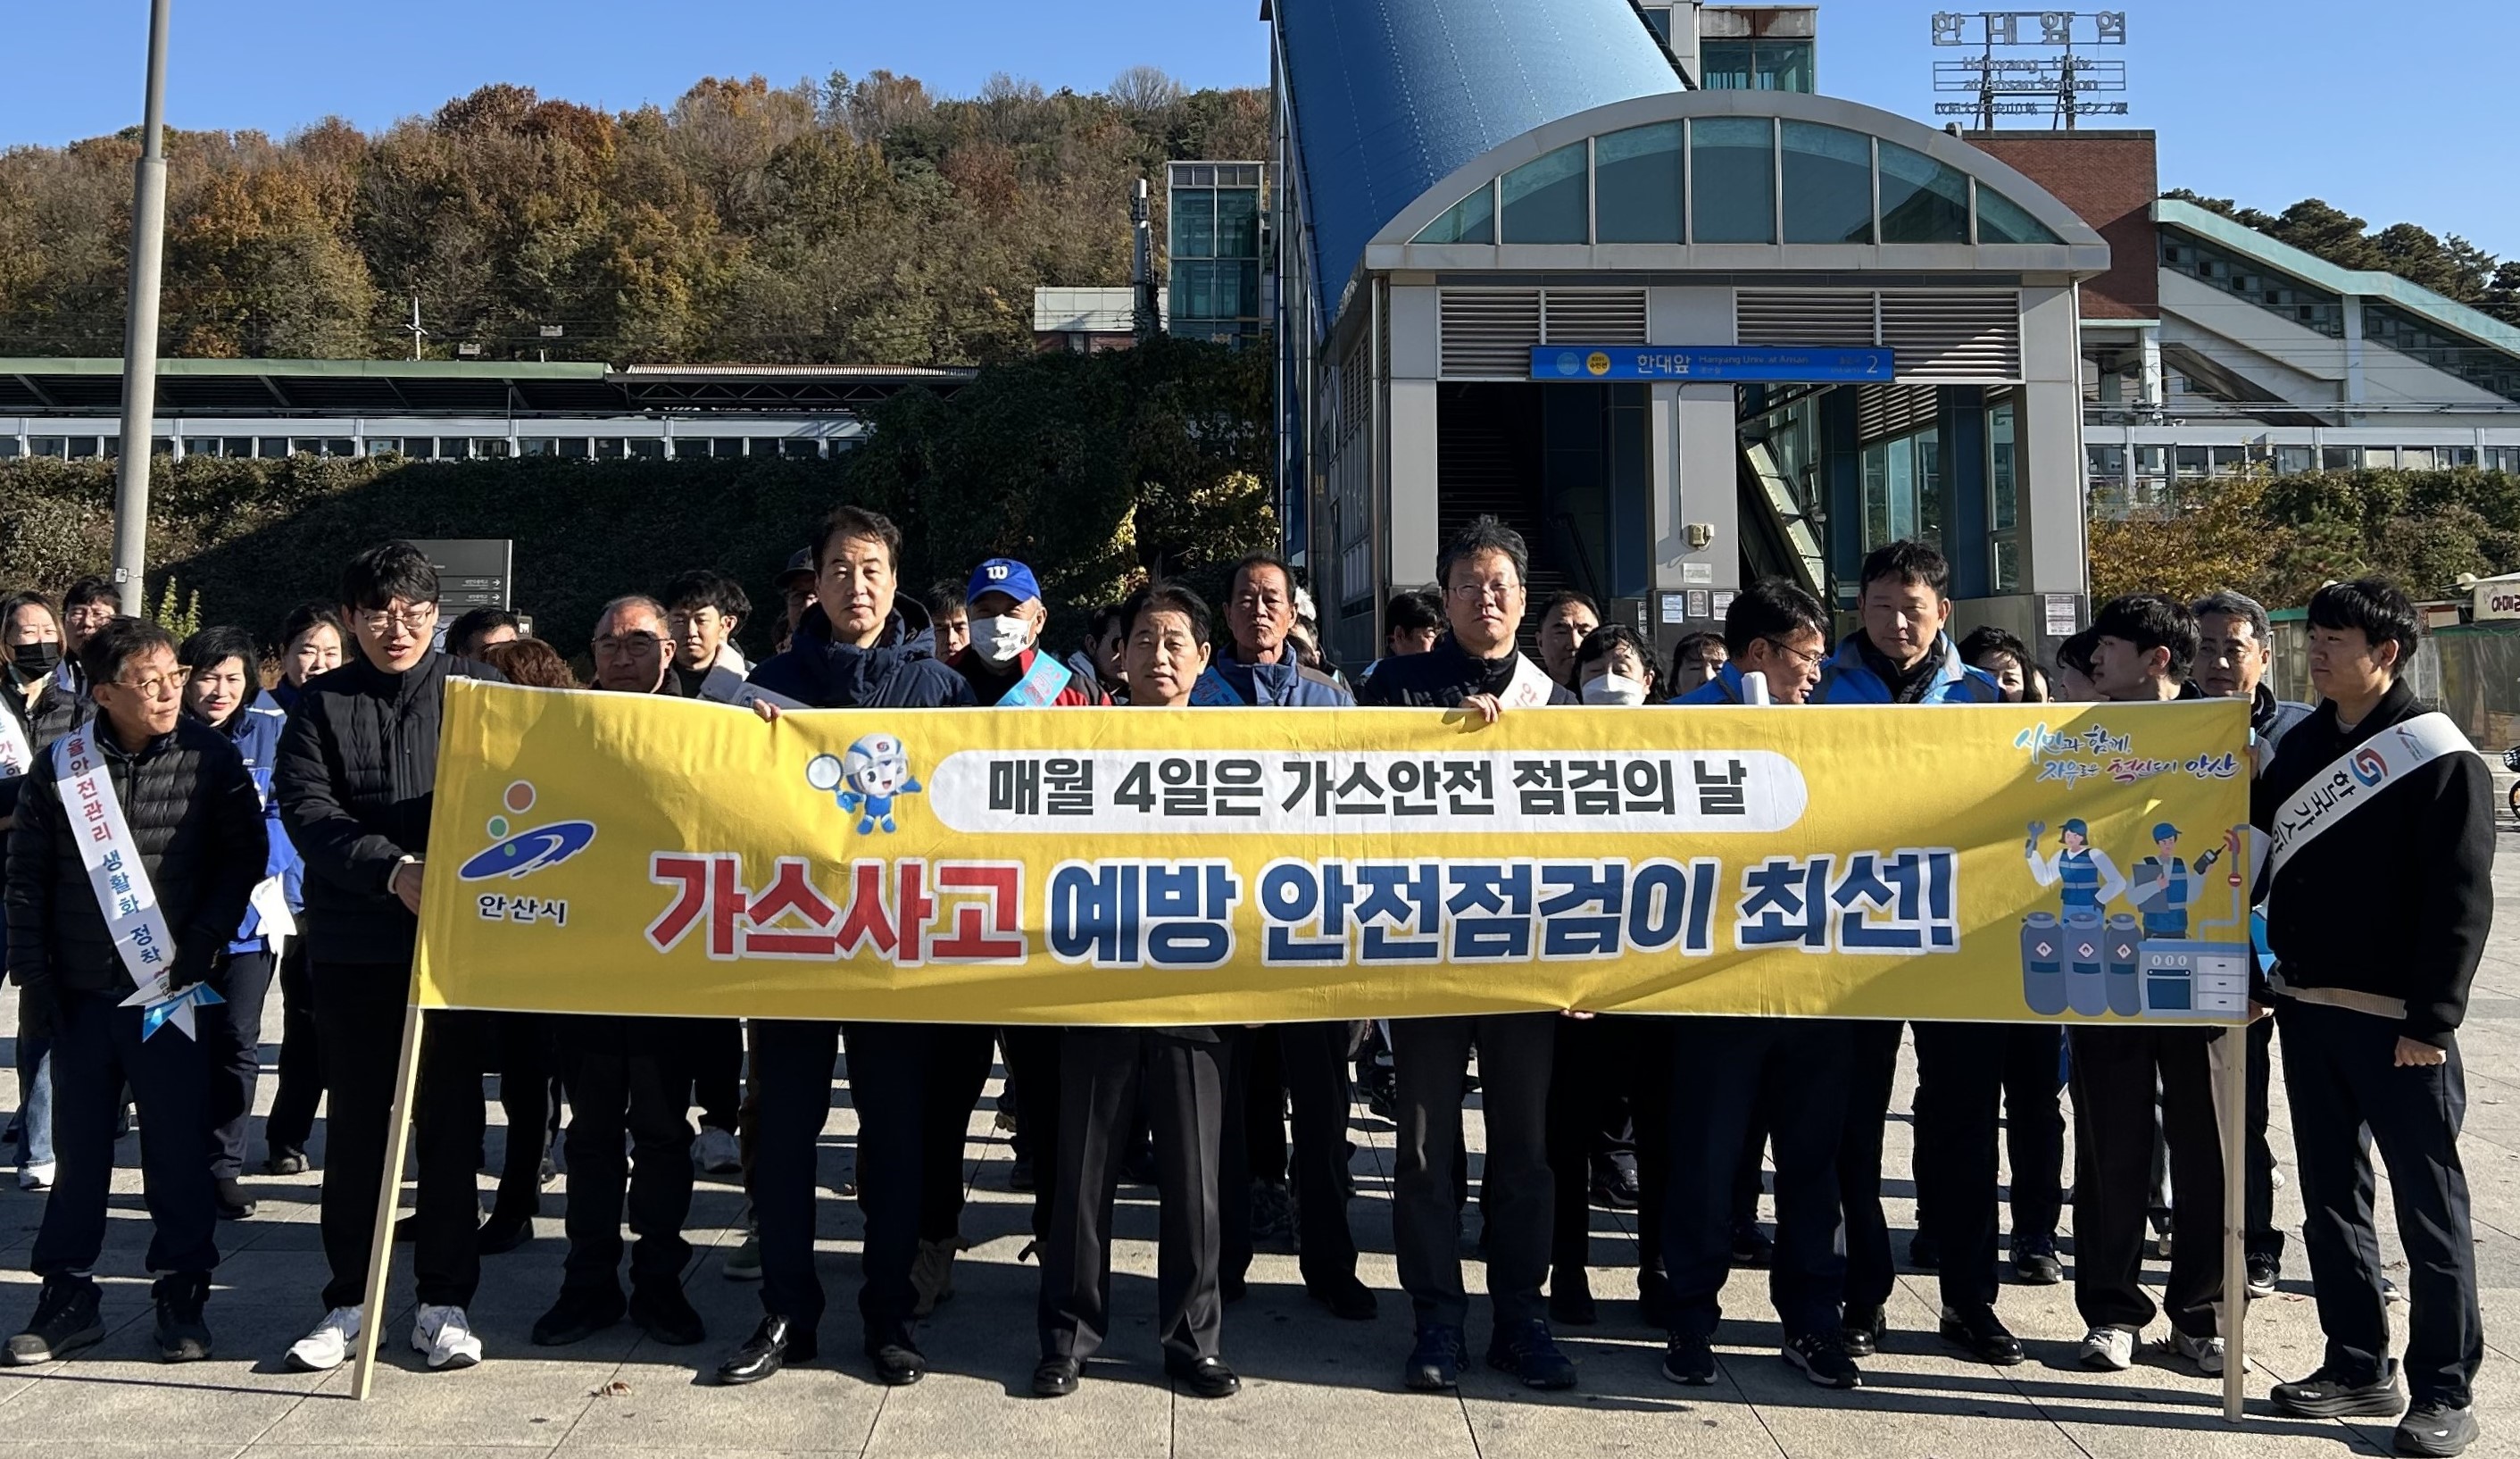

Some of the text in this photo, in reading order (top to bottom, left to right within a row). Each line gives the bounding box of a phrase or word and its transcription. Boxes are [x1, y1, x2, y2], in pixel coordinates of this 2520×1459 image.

[1932, 11, 2126, 46] 한대앞역
[1963, 55, 2039, 74] Hanyang
[1983, 76, 2036, 91] Ansan
[2039, 76, 2099, 92] Station
[1636, 354, 1692, 374] 한대앞
[1866, 354, 1878, 373] 2
[2014, 722, 2083, 763] 시민과
[988, 757, 1747, 817] 매월 4일은 가스안전 점검의 날
[2037, 753, 2239, 790] 자유로운 혁신도시 안산
[102, 849, 140, 917] 생활화
[129, 925, 162, 964] 정착
[479, 896, 565, 923] 안산시
[650, 851, 1955, 964] 가스사고 예방 안전점검이 최선!
